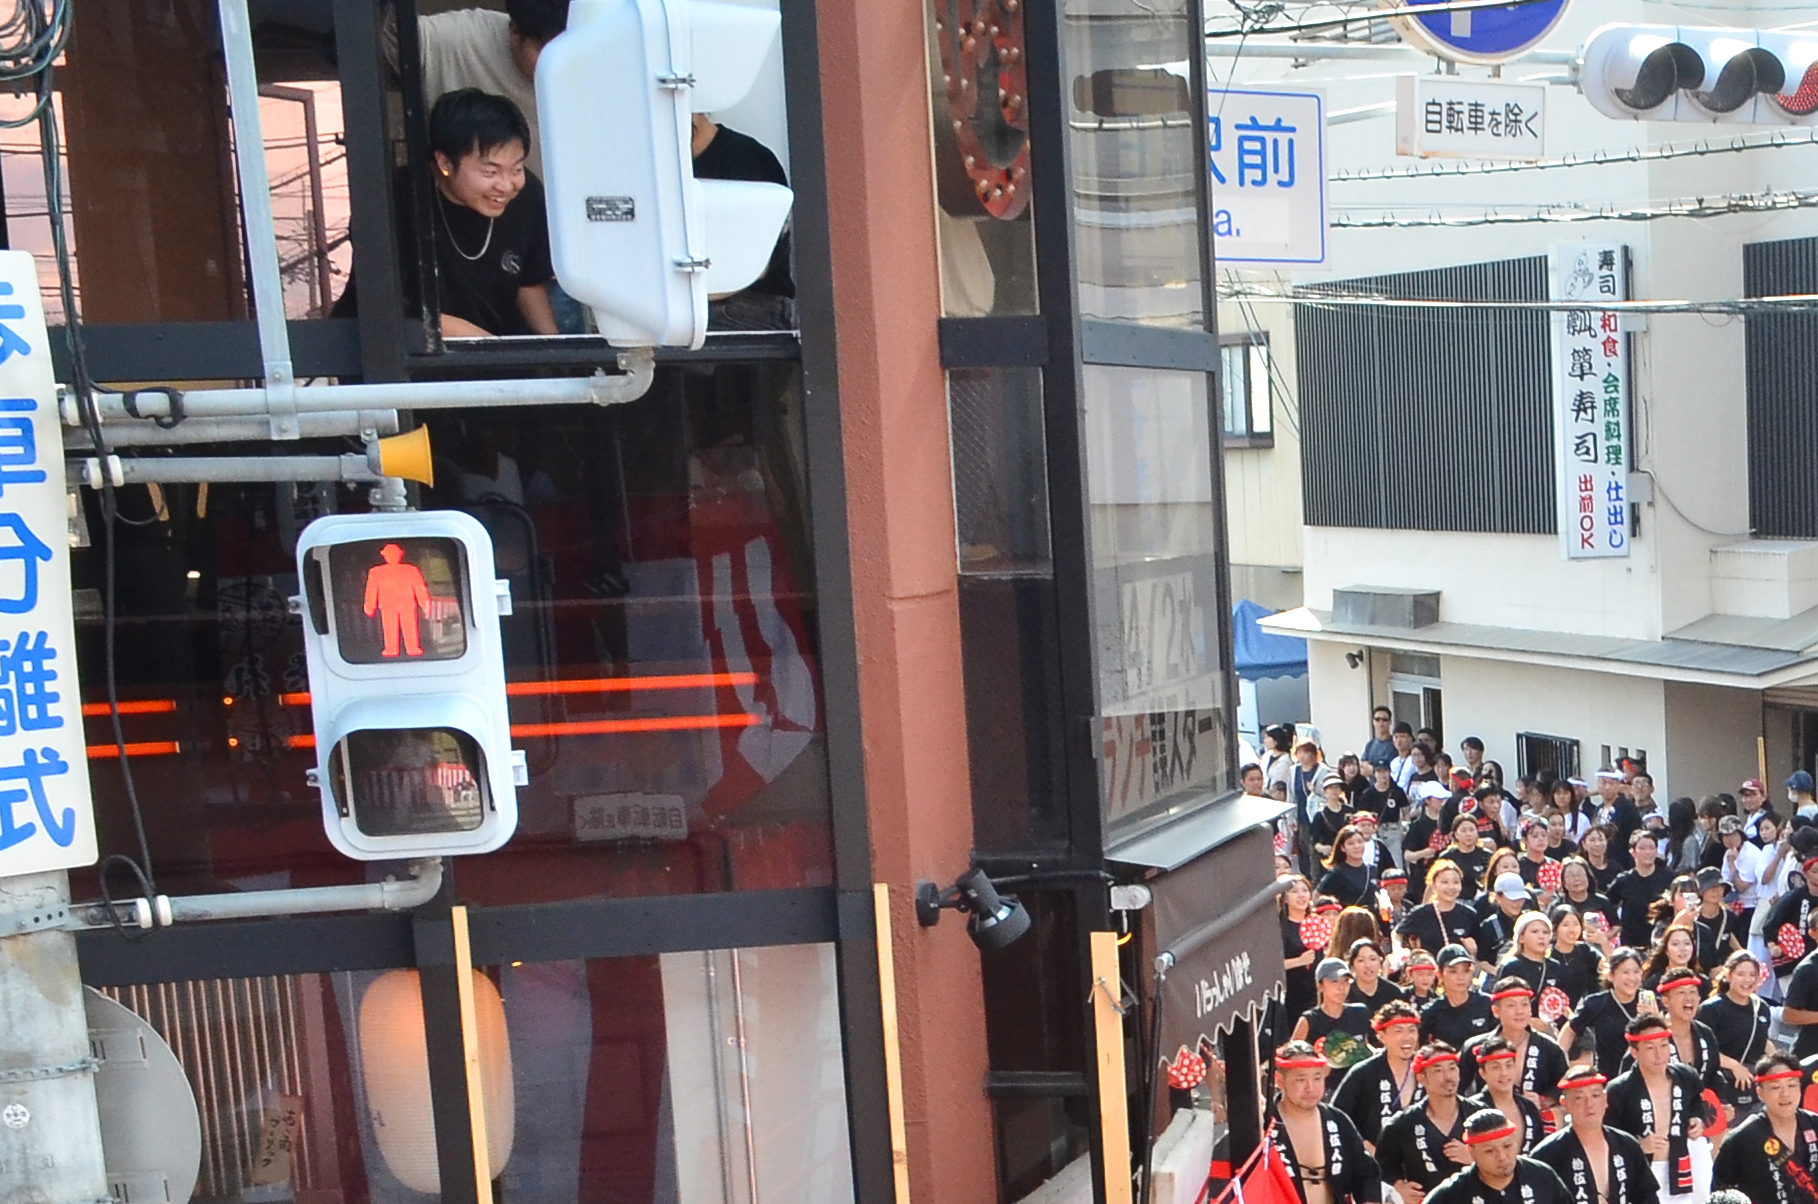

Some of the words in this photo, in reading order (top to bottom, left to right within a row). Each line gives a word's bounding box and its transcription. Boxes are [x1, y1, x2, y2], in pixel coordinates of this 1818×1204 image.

[1424, 97, 1538, 139] 自転車を除く
